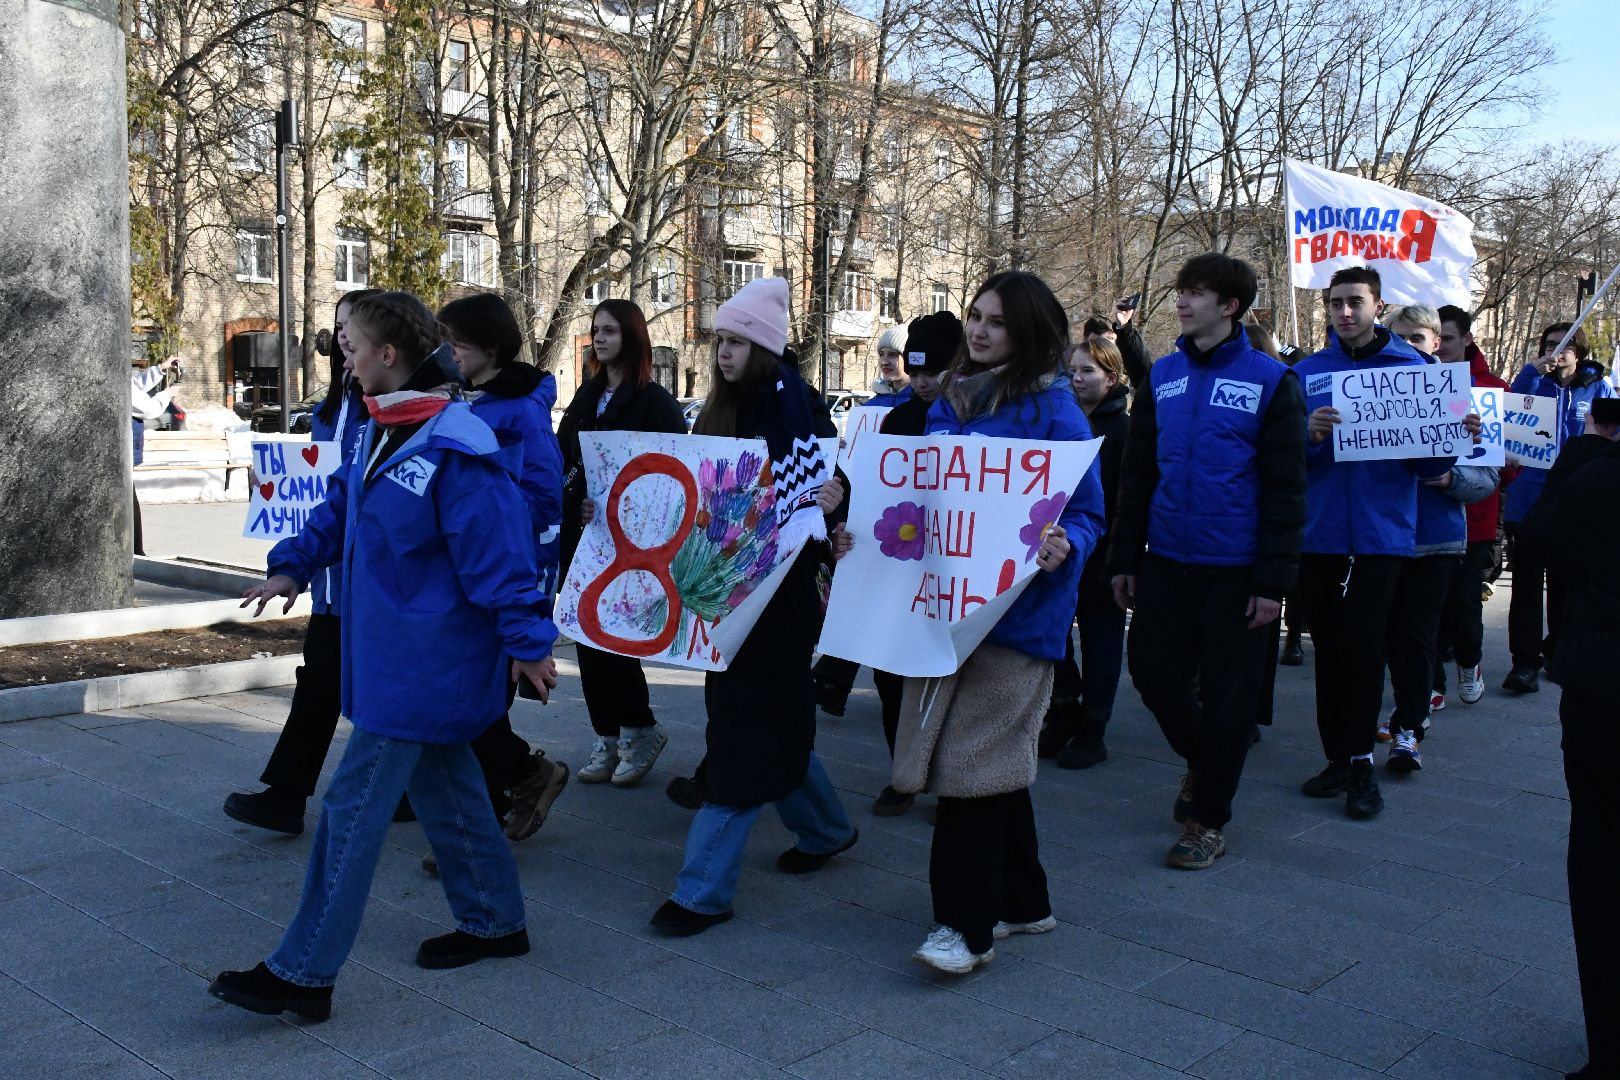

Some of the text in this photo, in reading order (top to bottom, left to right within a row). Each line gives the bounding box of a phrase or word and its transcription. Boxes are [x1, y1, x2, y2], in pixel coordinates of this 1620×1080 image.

[253, 443, 286, 475] ТЫ
[1432, 441, 1454, 456] ГО
[278, 474, 329, 502] САМА
